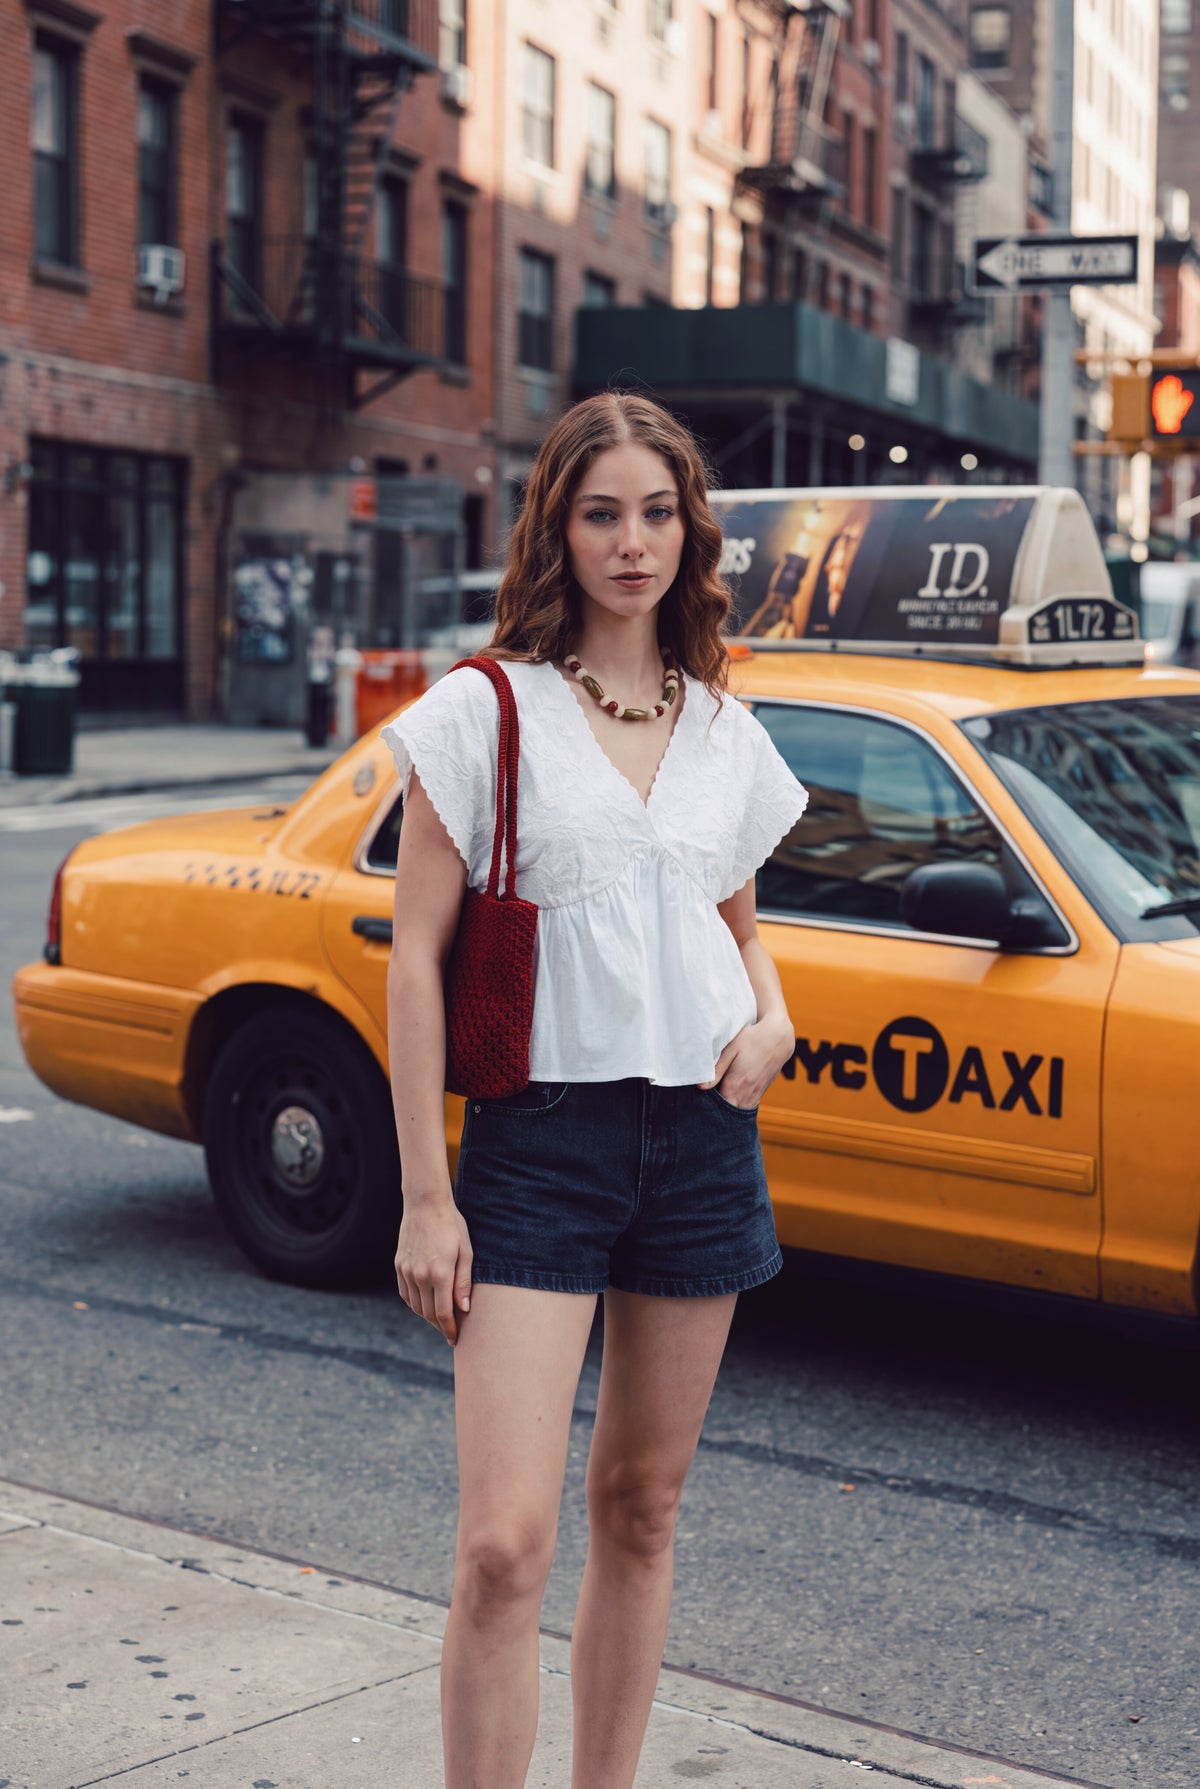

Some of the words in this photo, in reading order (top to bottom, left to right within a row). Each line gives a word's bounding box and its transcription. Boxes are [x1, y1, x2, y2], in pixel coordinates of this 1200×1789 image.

[1001, 247, 1041, 275] ONE
[1054, 604, 1106, 640] 1L72
[266, 870, 320, 899] 1L72
[885, 1031, 1064, 1119] TAXI
